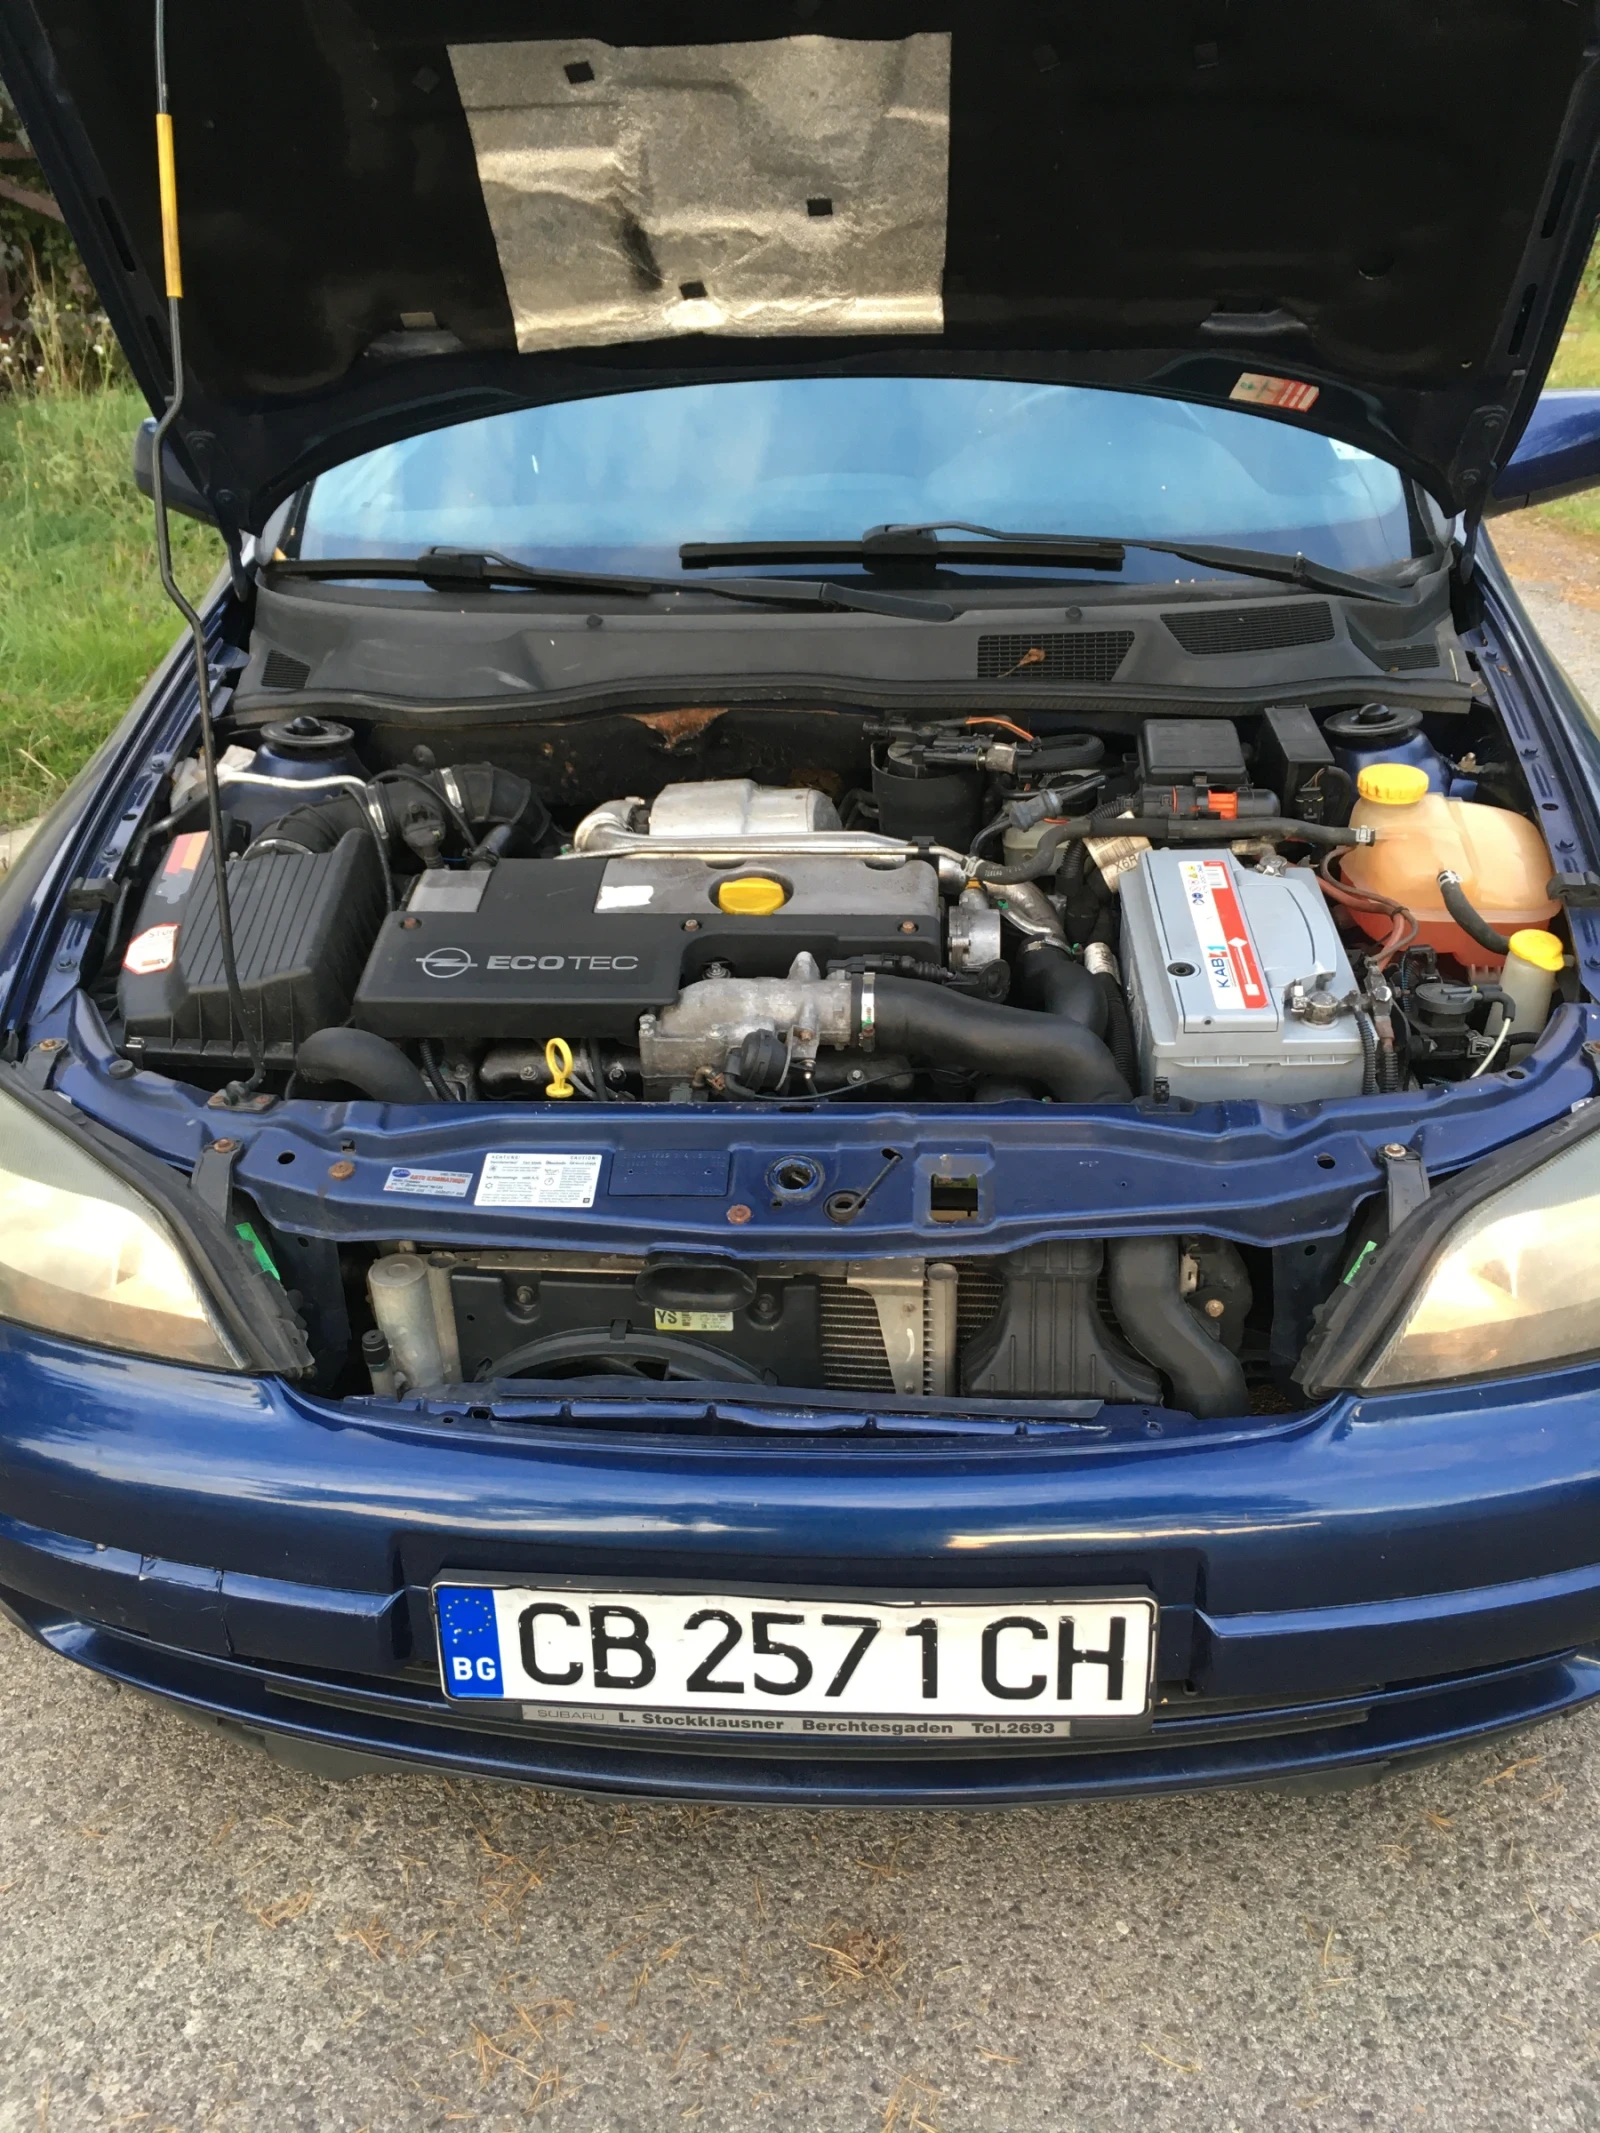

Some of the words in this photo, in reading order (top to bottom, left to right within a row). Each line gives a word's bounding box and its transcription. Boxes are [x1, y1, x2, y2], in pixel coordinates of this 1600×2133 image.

[486, 955, 639, 971] ECOTEC
[656, 1310, 678, 1324] YS
[518, 1602, 657, 1690] CB
[683, 1608, 939, 1699] 2571
[981, 1606, 1127, 1700] CH
[453, 1657, 497, 1681] BG
[537, 1709, 605, 1721] SUBARU
[618, 1712, 636, 1724] L.
[641, 1713, 785, 1730] Stockklausner
[802, 1720, 954, 1736] Berchtesgaden
[971, 1722, 1055, 1735] Tel.2693
